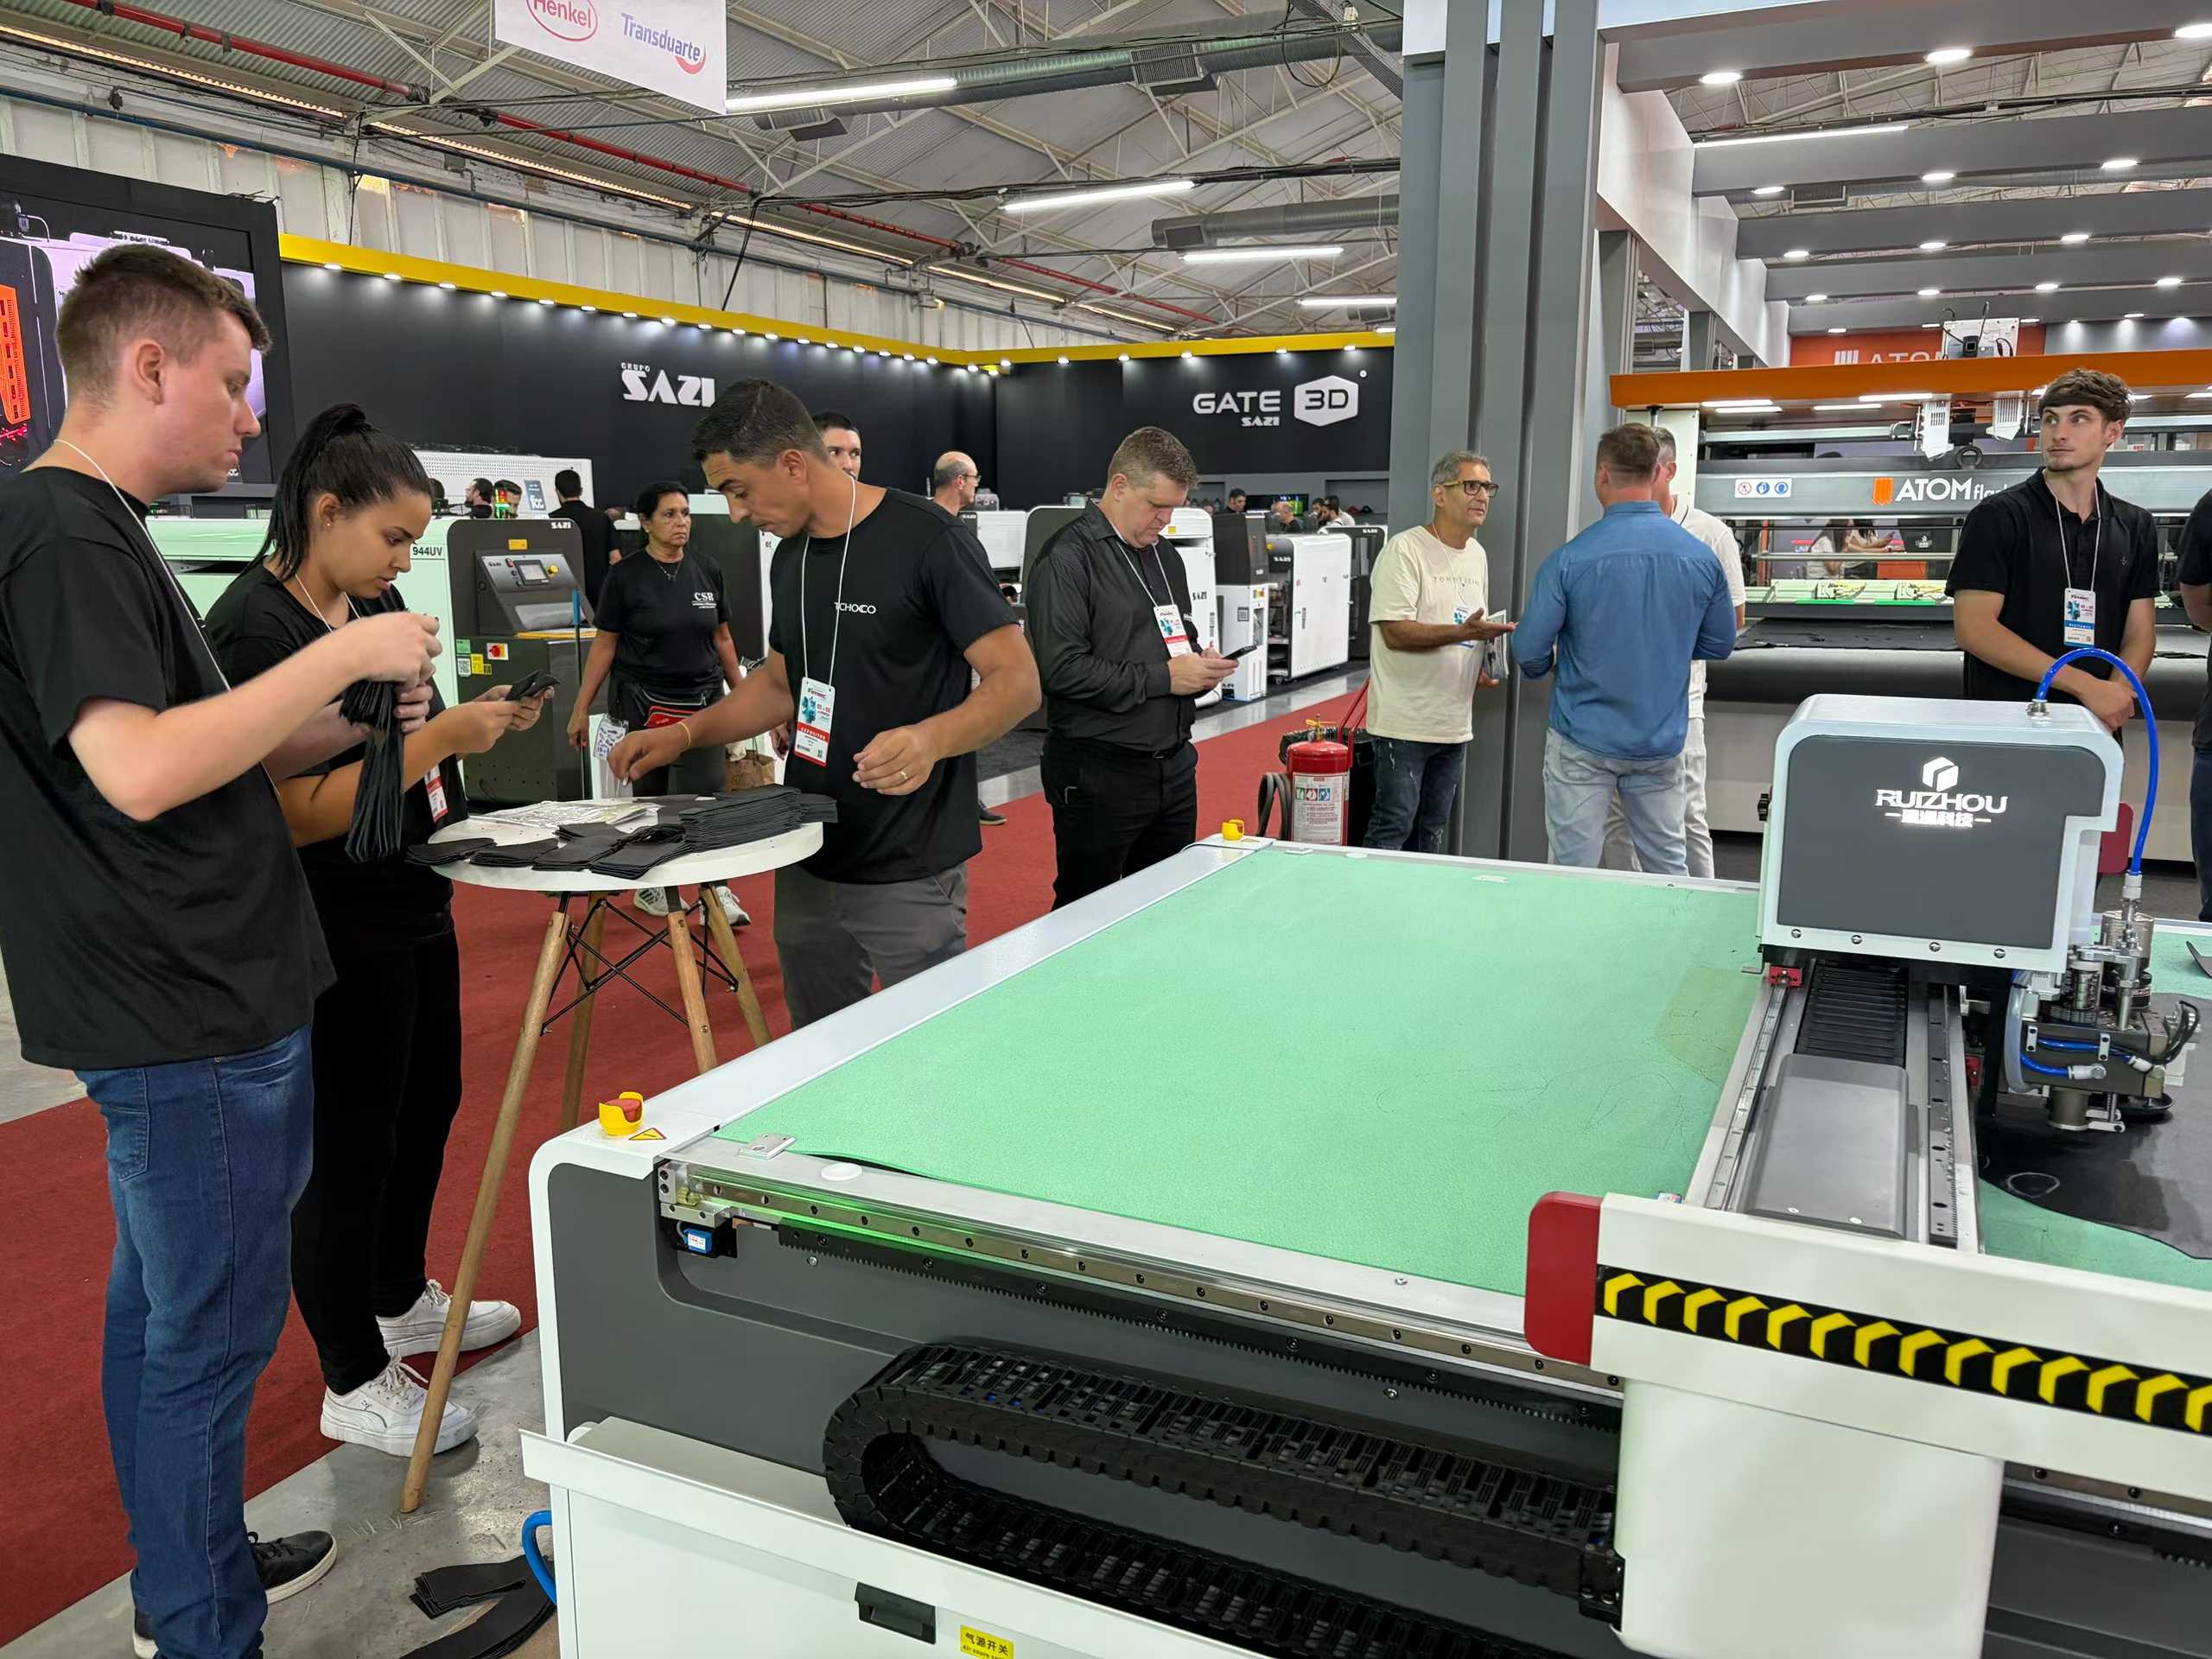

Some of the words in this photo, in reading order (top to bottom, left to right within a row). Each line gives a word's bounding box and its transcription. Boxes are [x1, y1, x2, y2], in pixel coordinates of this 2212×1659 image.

[533, 0, 591, 29] Henkel
[621, 12, 701, 61] Transduarte
[620, 362, 651, 372] GRUPO
[621, 369, 715, 408] SAZI
[1192, 391, 1281, 415] GATE
[1305, 389, 1349, 410] 3D
[1242, 416, 1280, 427] SAZI
[1895, 477, 1972, 501] ATOM
[1973, 484, 2007, 500] fla
[412, 546, 442, 556] 944UV
[1874, 789, 2008, 814] RUIZHOU
